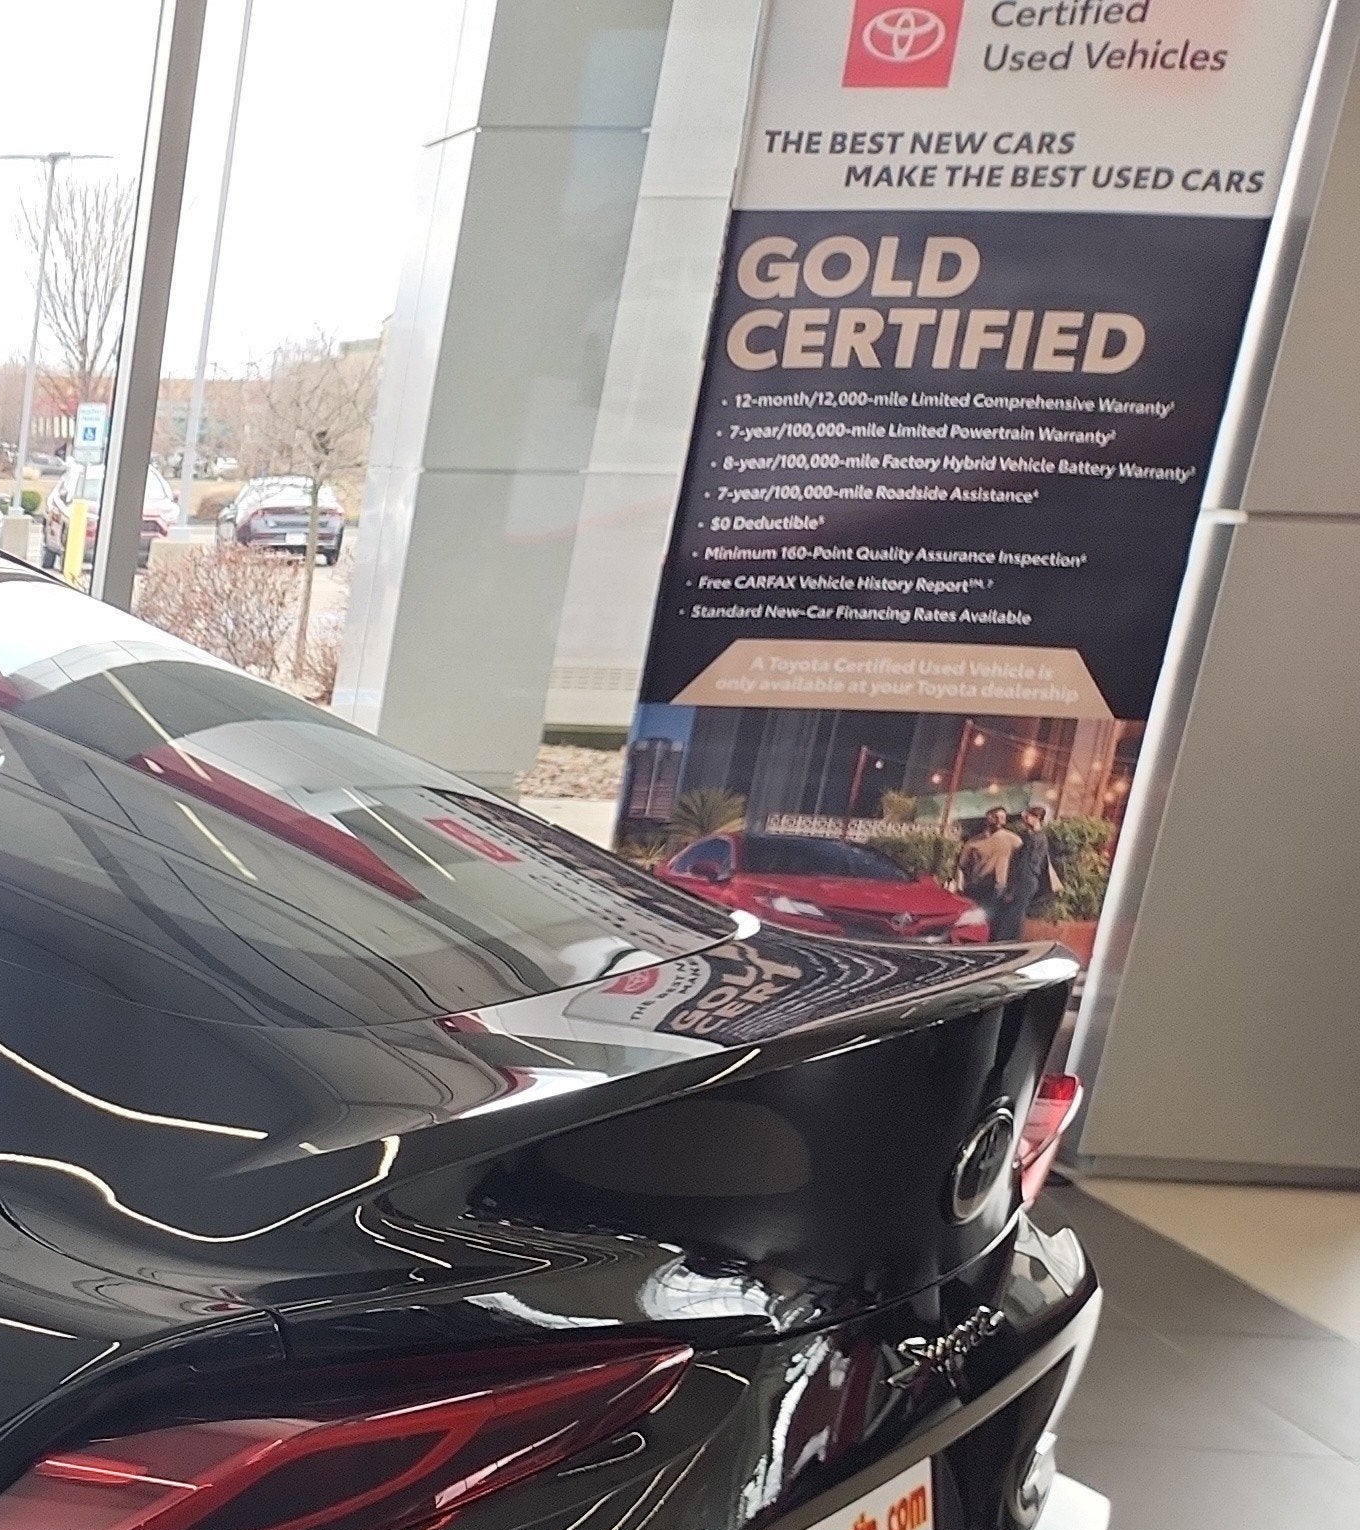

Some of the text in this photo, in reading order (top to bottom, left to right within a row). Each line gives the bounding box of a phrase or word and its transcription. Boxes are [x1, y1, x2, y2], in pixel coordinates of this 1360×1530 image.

[991, 0, 1148, 28] Certified
[984, 39, 1228, 72] Used Vehicles
[764, 130, 1076, 155] THE BEST NEW CARS
[844, 164, 1265, 194] MAKE THE BEST USED CARS
[737, 236, 981, 299] GOLD
[726, 307, 1147, 374] CERTIFIED
[735, 391, 908, 408] 12-month/12,000-mile
[911, 392, 970, 408] Limited
[973, 393, 1095, 412] Comprehensive
[730, 422, 886, 442] 7-year/100,000-mile
[888, 422, 948, 439] Limited
[950, 424, 1034, 441] Powertrain
[723, 453, 880, 472] 8-year/100,000-mile
[882, 453, 941, 473] Factory
[943, 455, 998, 473] Hybrid
[999, 457, 1056, 473] Vehicle
[1058, 459, 1116, 479] Battery
[717, 484, 873, 503] 7-year/100,000-mile
[876, 485, 948, 501] Roadside
[710, 515, 730, 531] $0
[704, 546, 778, 561] Minimum
[781, 546, 854, 561] 160-Point
[856, 546, 914, 564] Quality
[915, 547, 996, 564] Assurance
[698, 575, 732, 590] Free
[734, 575, 798, 590] CARFAX
[799, 575, 855, 590] Vehicle
[857, 576, 914, 594] History
[690, 604, 1032, 625] Standard New-Car Financing Rates Available
[751, 656, 1053, 681] A Toyota Certified Used Vehicle is
[715, 676, 1079, 704] only available at your Toyota dealership
